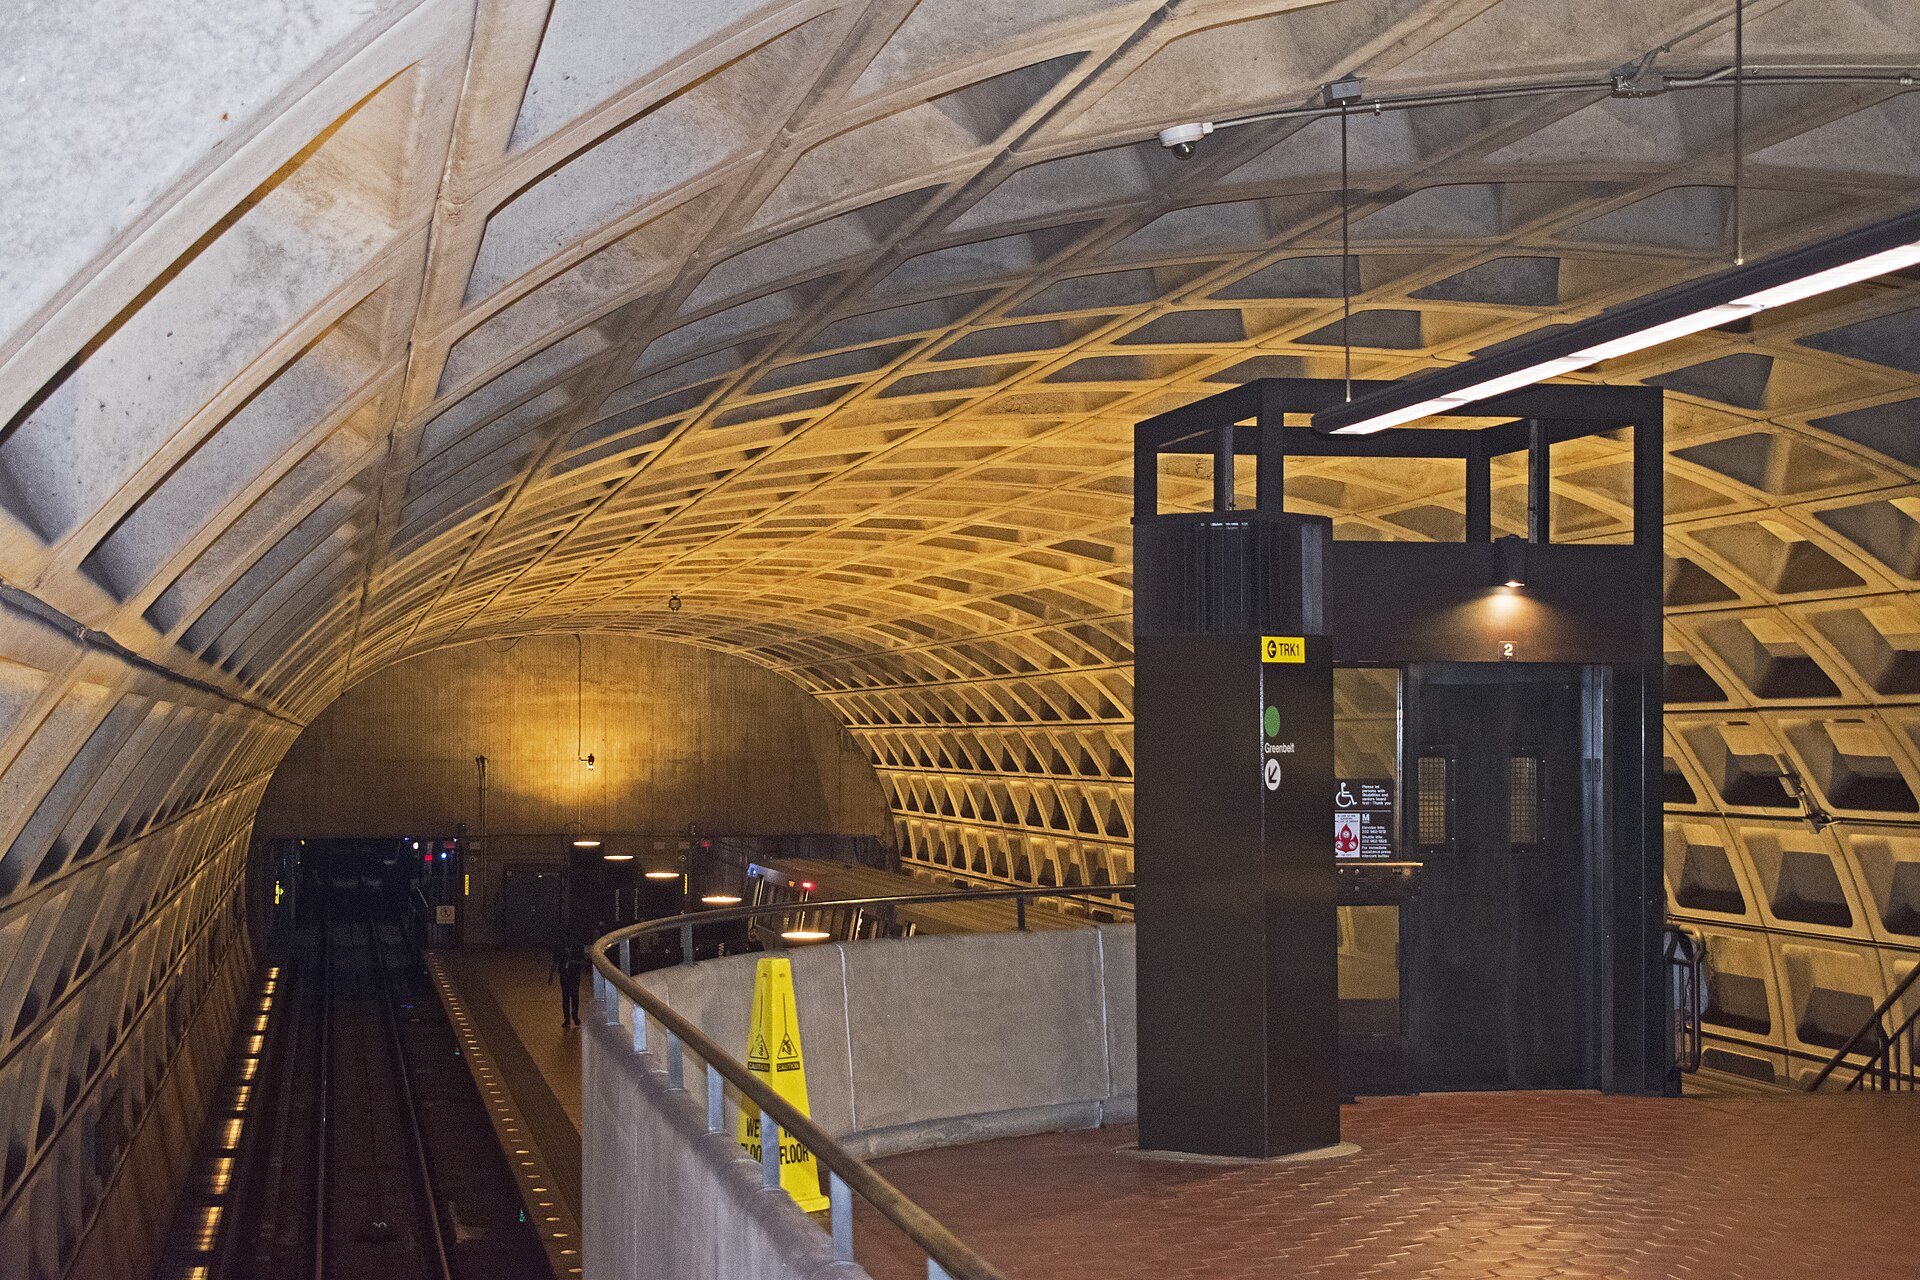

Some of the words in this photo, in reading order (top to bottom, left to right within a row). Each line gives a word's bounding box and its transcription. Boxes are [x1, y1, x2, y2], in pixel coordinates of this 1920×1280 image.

[1279, 643, 1300, 656] TRK1
[1504, 643, 1513, 656] 2
[1264, 742, 1295, 753] Greenbelt
[780, 1144, 809, 1165] FLOOR
